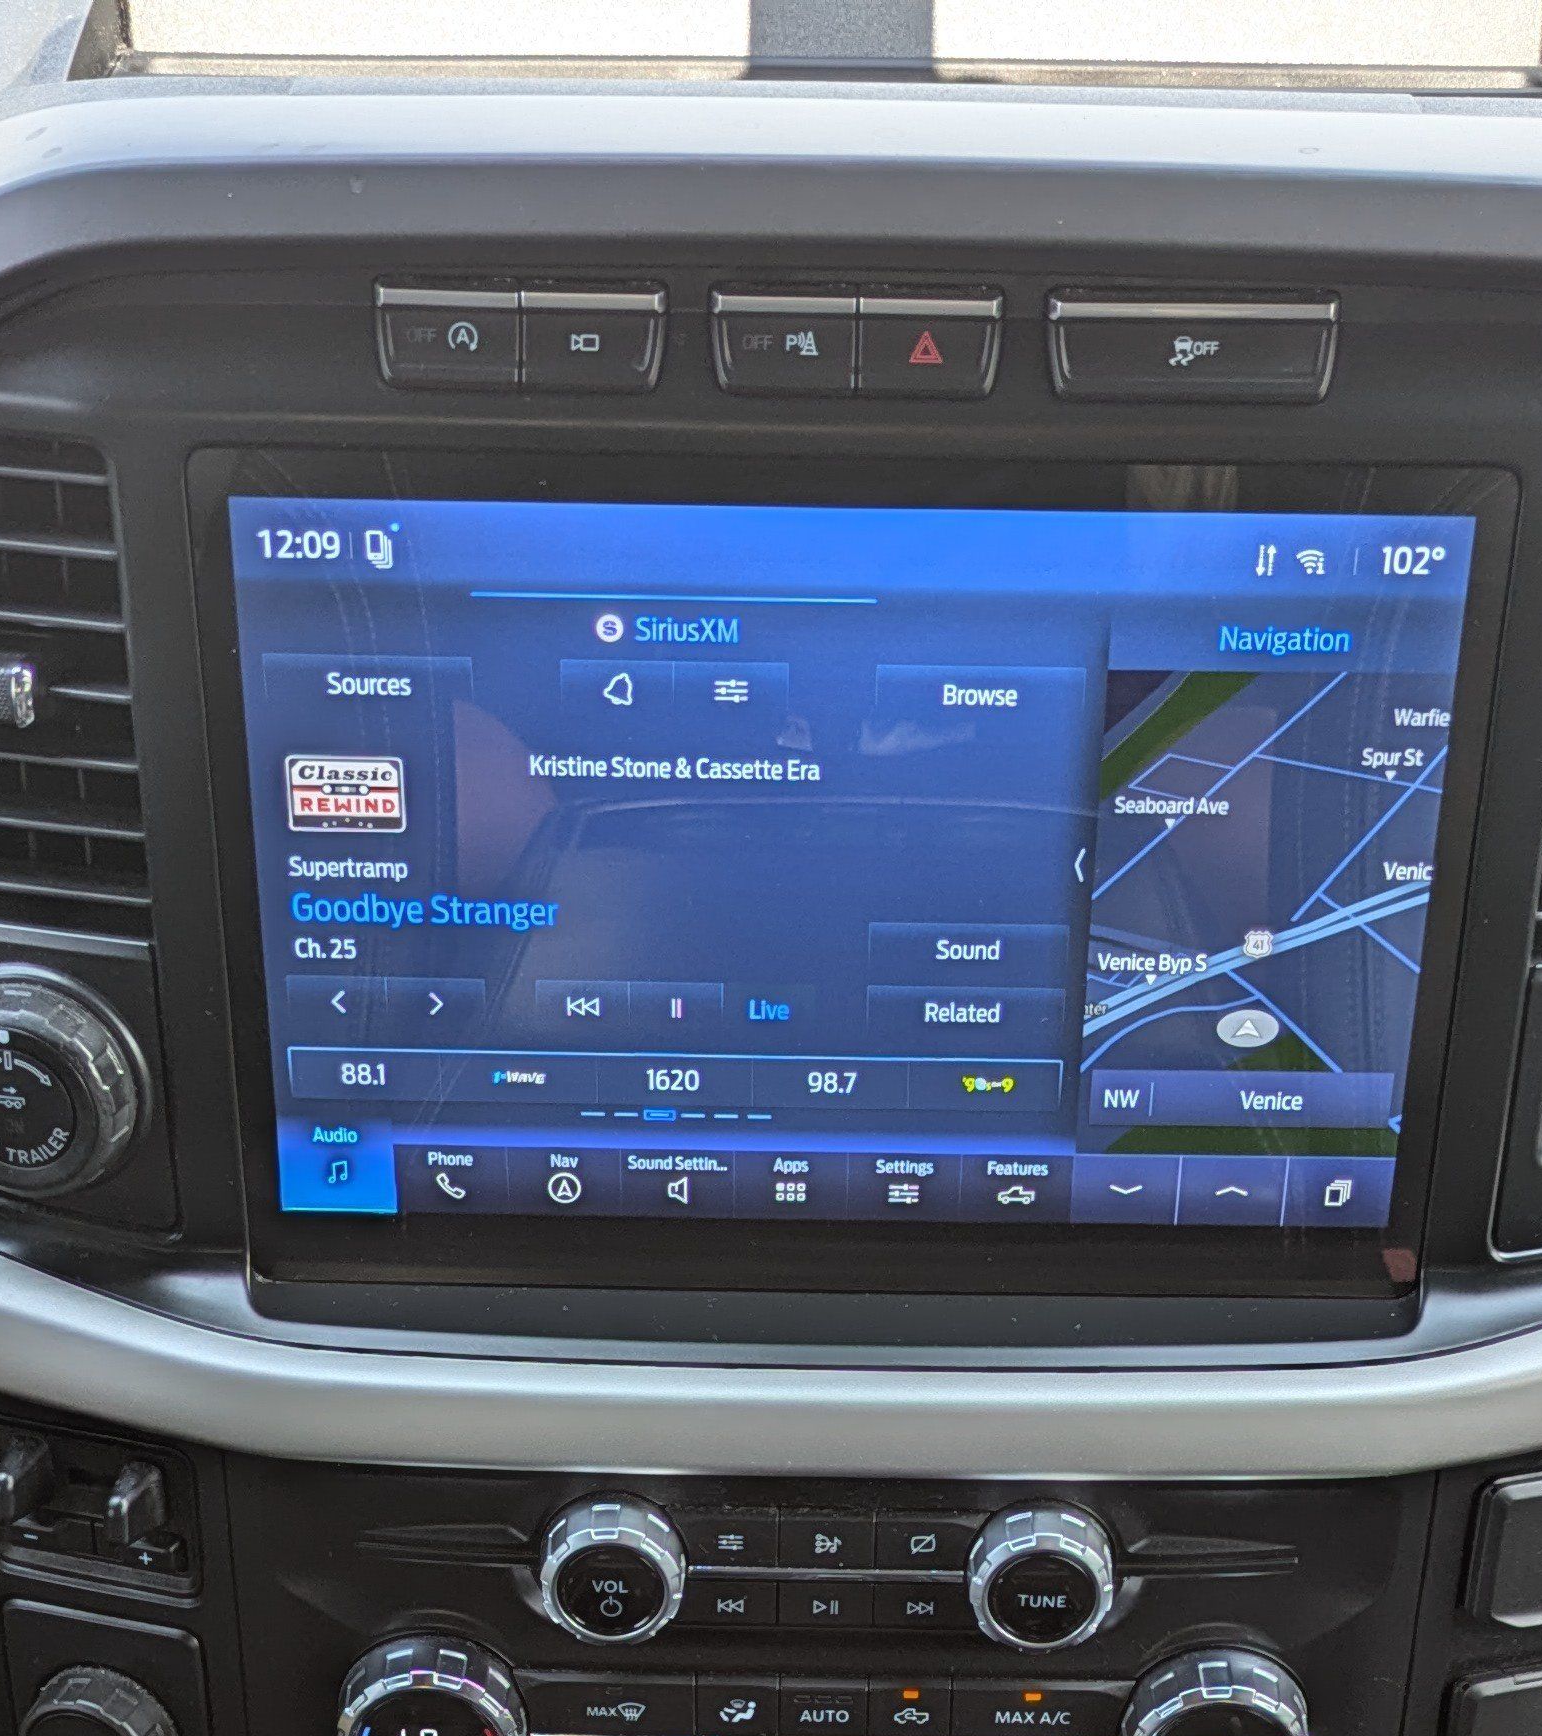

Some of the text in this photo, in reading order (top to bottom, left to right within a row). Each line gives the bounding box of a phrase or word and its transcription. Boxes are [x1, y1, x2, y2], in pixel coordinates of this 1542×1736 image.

[1193, 340, 1220, 356] OFF
[257, 529, 341, 560] 12:09
[1382, 546, 1445, 576] 102°
[634, 617, 739, 643] SiriusXM
[1219, 625, 1350, 656] Navigation
[326, 672, 413, 697] Sources
[942, 684, 1018, 706] Browse
[1394, 708, 1450, 728] Warfie
[529, 754, 821, 782] Kristine Stone & Cassette Era
[1362, 749, 1423, 769] Spur St
[298, 764, 393, 782] Classic
[300, 797, 396, 814] REWIND
[1114, 796, 1229, 816] Seaboard Ave
[288, 856, 408, 882] Supertramp
[1383, 862, 1433, 881] Venic
[292, 892, 559, 931] Goodbye Stranger
[294, 938, 357, 959] Ch. 25
[936, 940, 1001, 960] Sound
[1098, 953, 1207, 974] Venice Byp S
[749, 999, 790, 1021] Live
[924, 1003, 1001, 1024] Related
[341, 1063, 386, 1085] 88.1
[646, 1069, 700, 1091] 1620
[808, 1072, 857, 1094] 98.7
[1103, 1089, 1140, 1108] NW
[1240, 1090, 1303, 1111] Venice
[313, 1126, 358, 1144] Audio
[5, 1127, 70, 1165] TRAILER
[427, 1151, 473, 1168] Phone
[550, 1154, 578, 1168] Nav
[628, 1155, 727, 1172] Sound Settin...
[773, 1158, 809, 1174] Apps
[876, 1159, 933, 1176] Settings
[987, 1161, 1048, 1176] Features
[591, 1579, 629, 1594] VOL
[1017, 1594, 1067, 1609] TUNE
[586, 1706, 617, 1718] MAX
[799, 1709, 850, 1724] AUTO
[995, 1711, 1072, 1726] MAX A/C
